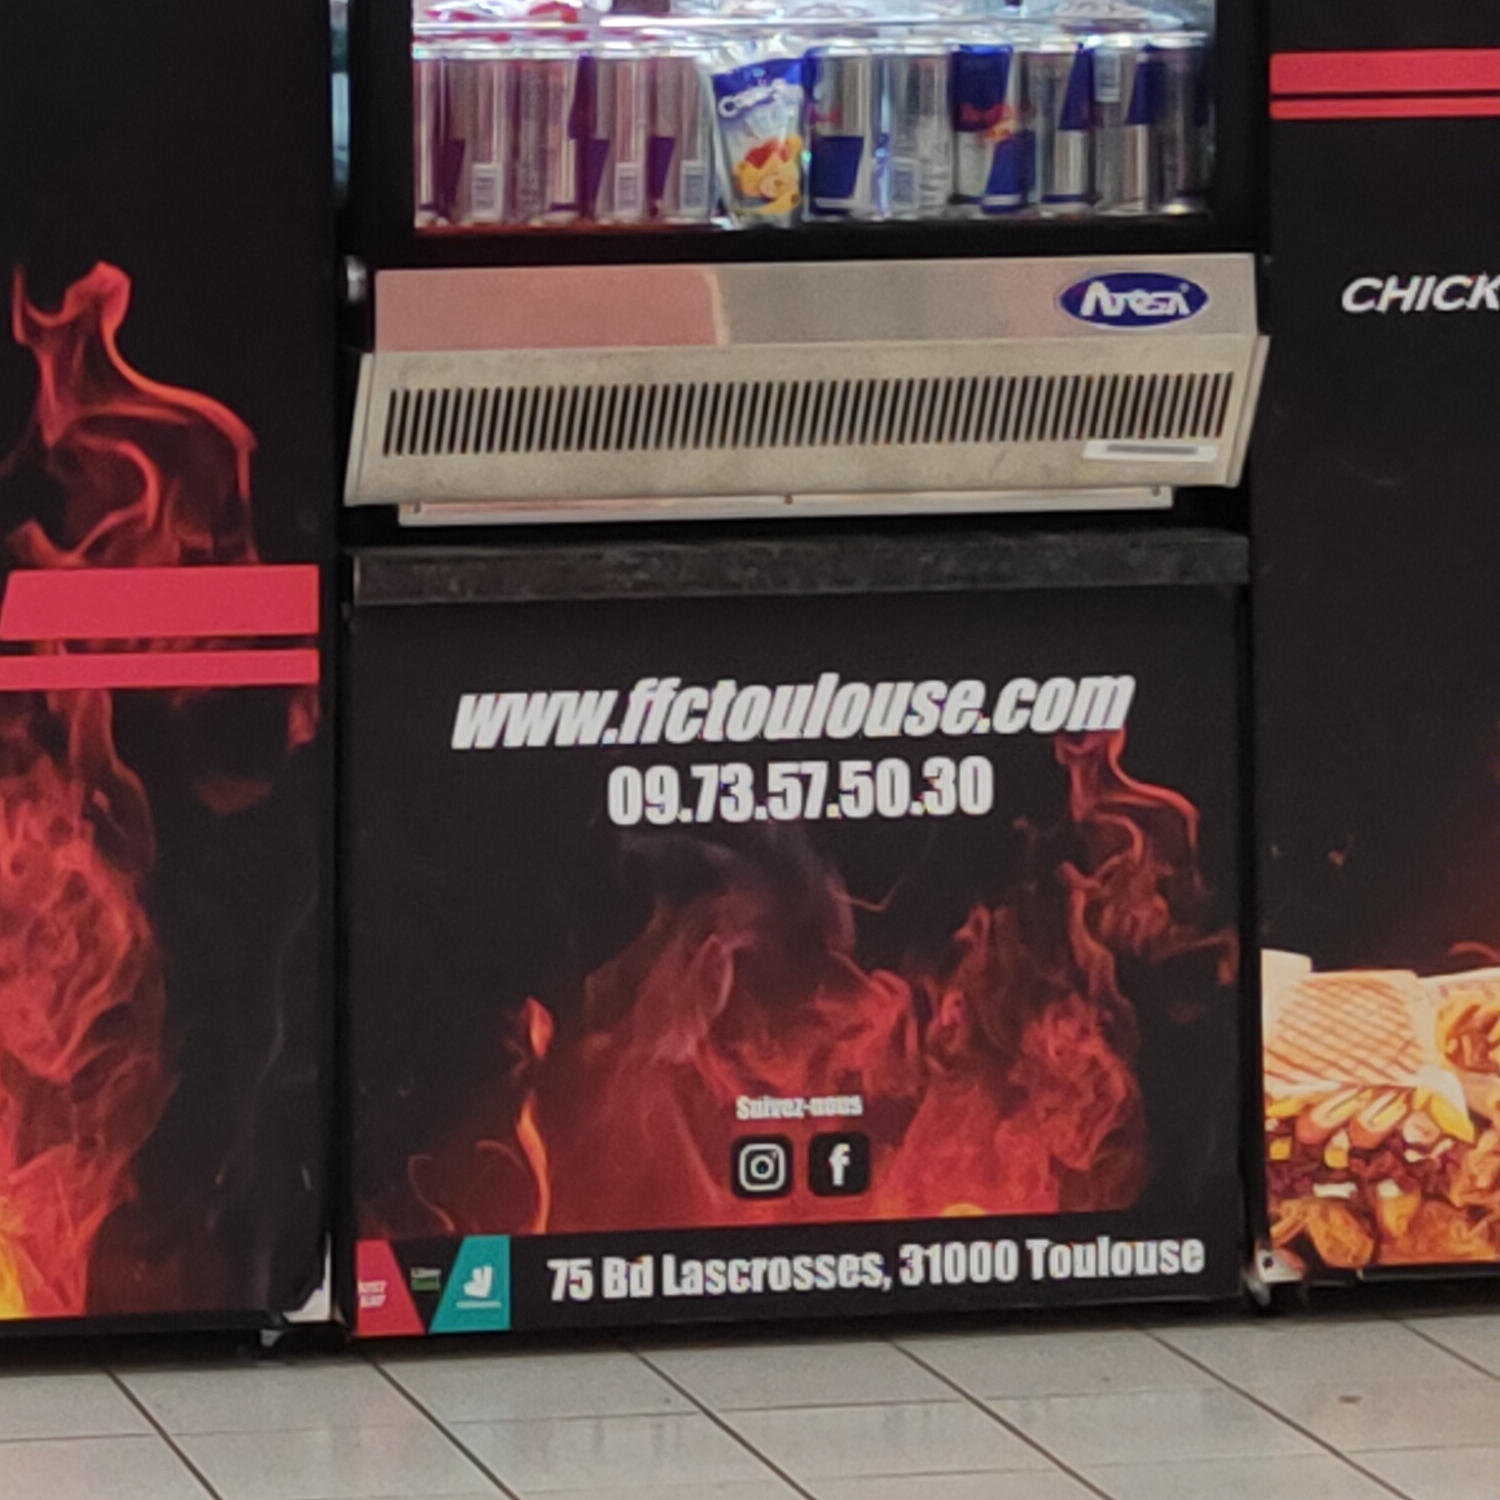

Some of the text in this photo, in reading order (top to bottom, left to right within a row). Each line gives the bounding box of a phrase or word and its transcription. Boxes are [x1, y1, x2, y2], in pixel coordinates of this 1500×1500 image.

[451, 672, 1136, 750] www.ffctoulouse.com
[607, 756, 994, 825] 09.73.57.50.30
[547, 1235, 1205, 1302] 75 Bd Lascrosses, 31000 Toulouse
